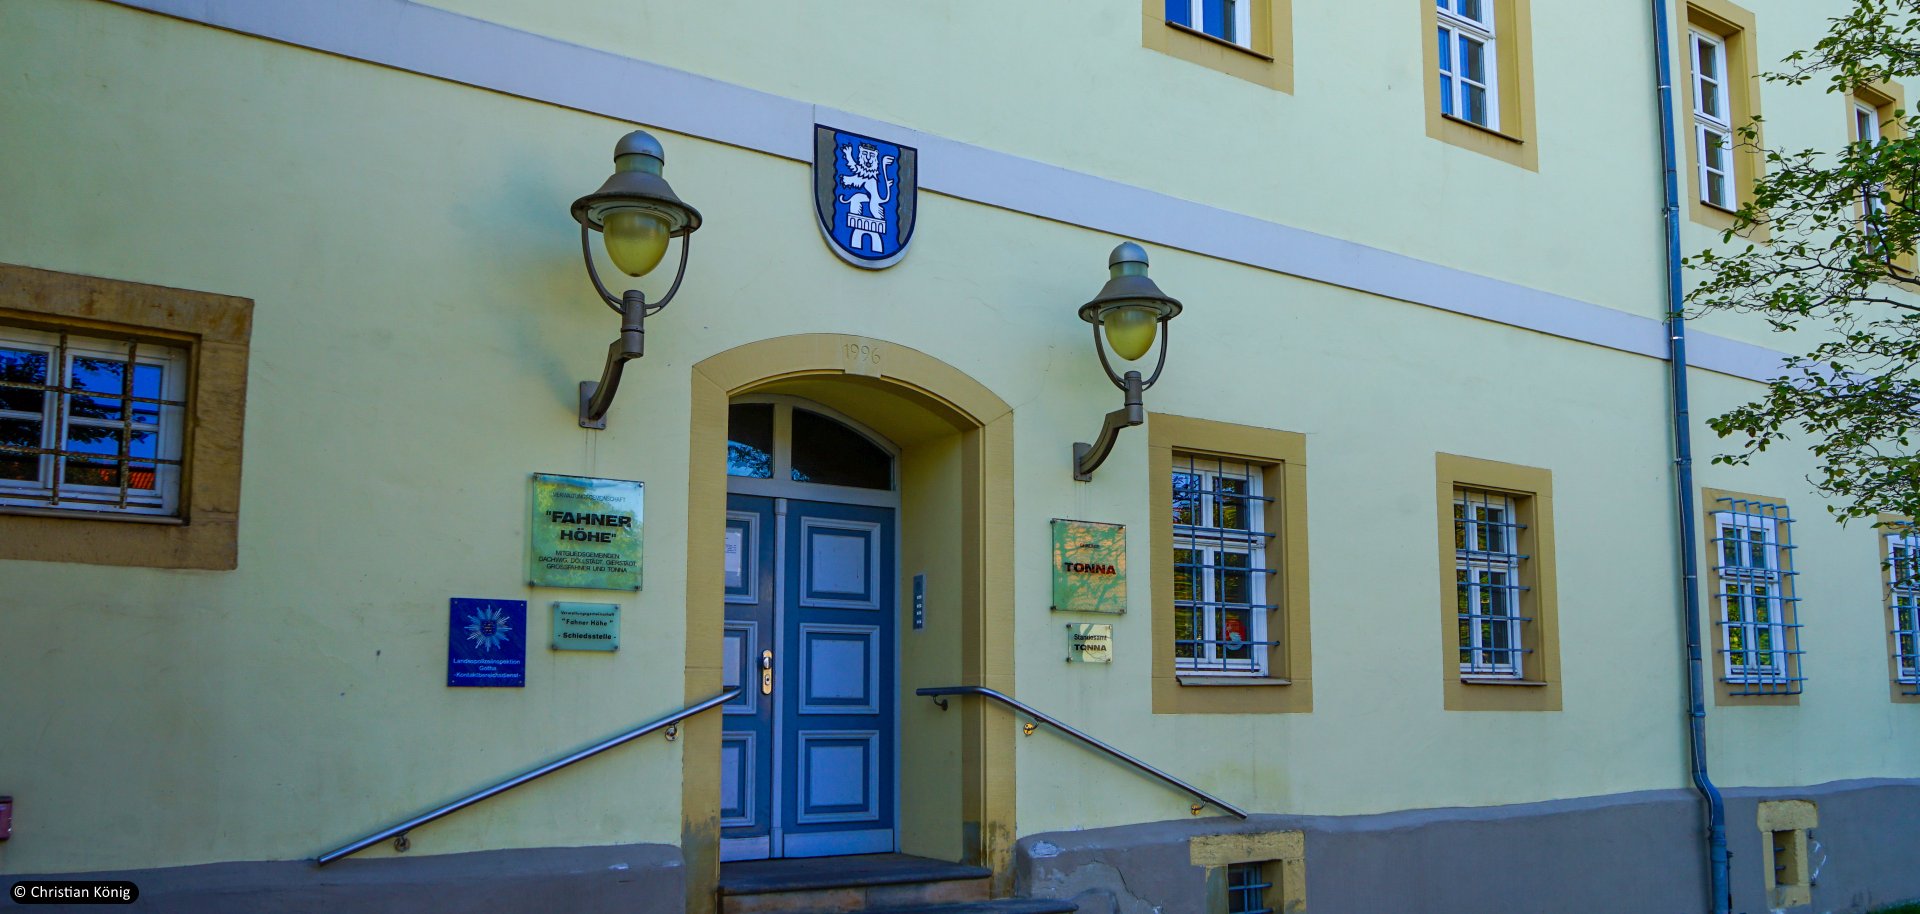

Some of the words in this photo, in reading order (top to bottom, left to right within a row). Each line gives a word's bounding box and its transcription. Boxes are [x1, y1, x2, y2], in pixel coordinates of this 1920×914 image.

[843, 343, 881, 364] 1996
[546, 510, 632, 528] "FAHNER
[560, 527, 617, 543] HÖHE"
[1064, 562, 1116, 575] TONNA
[562, 632, 612, 640] Schiedsstelle
[1074, 644, 1107, 652] TONNA
